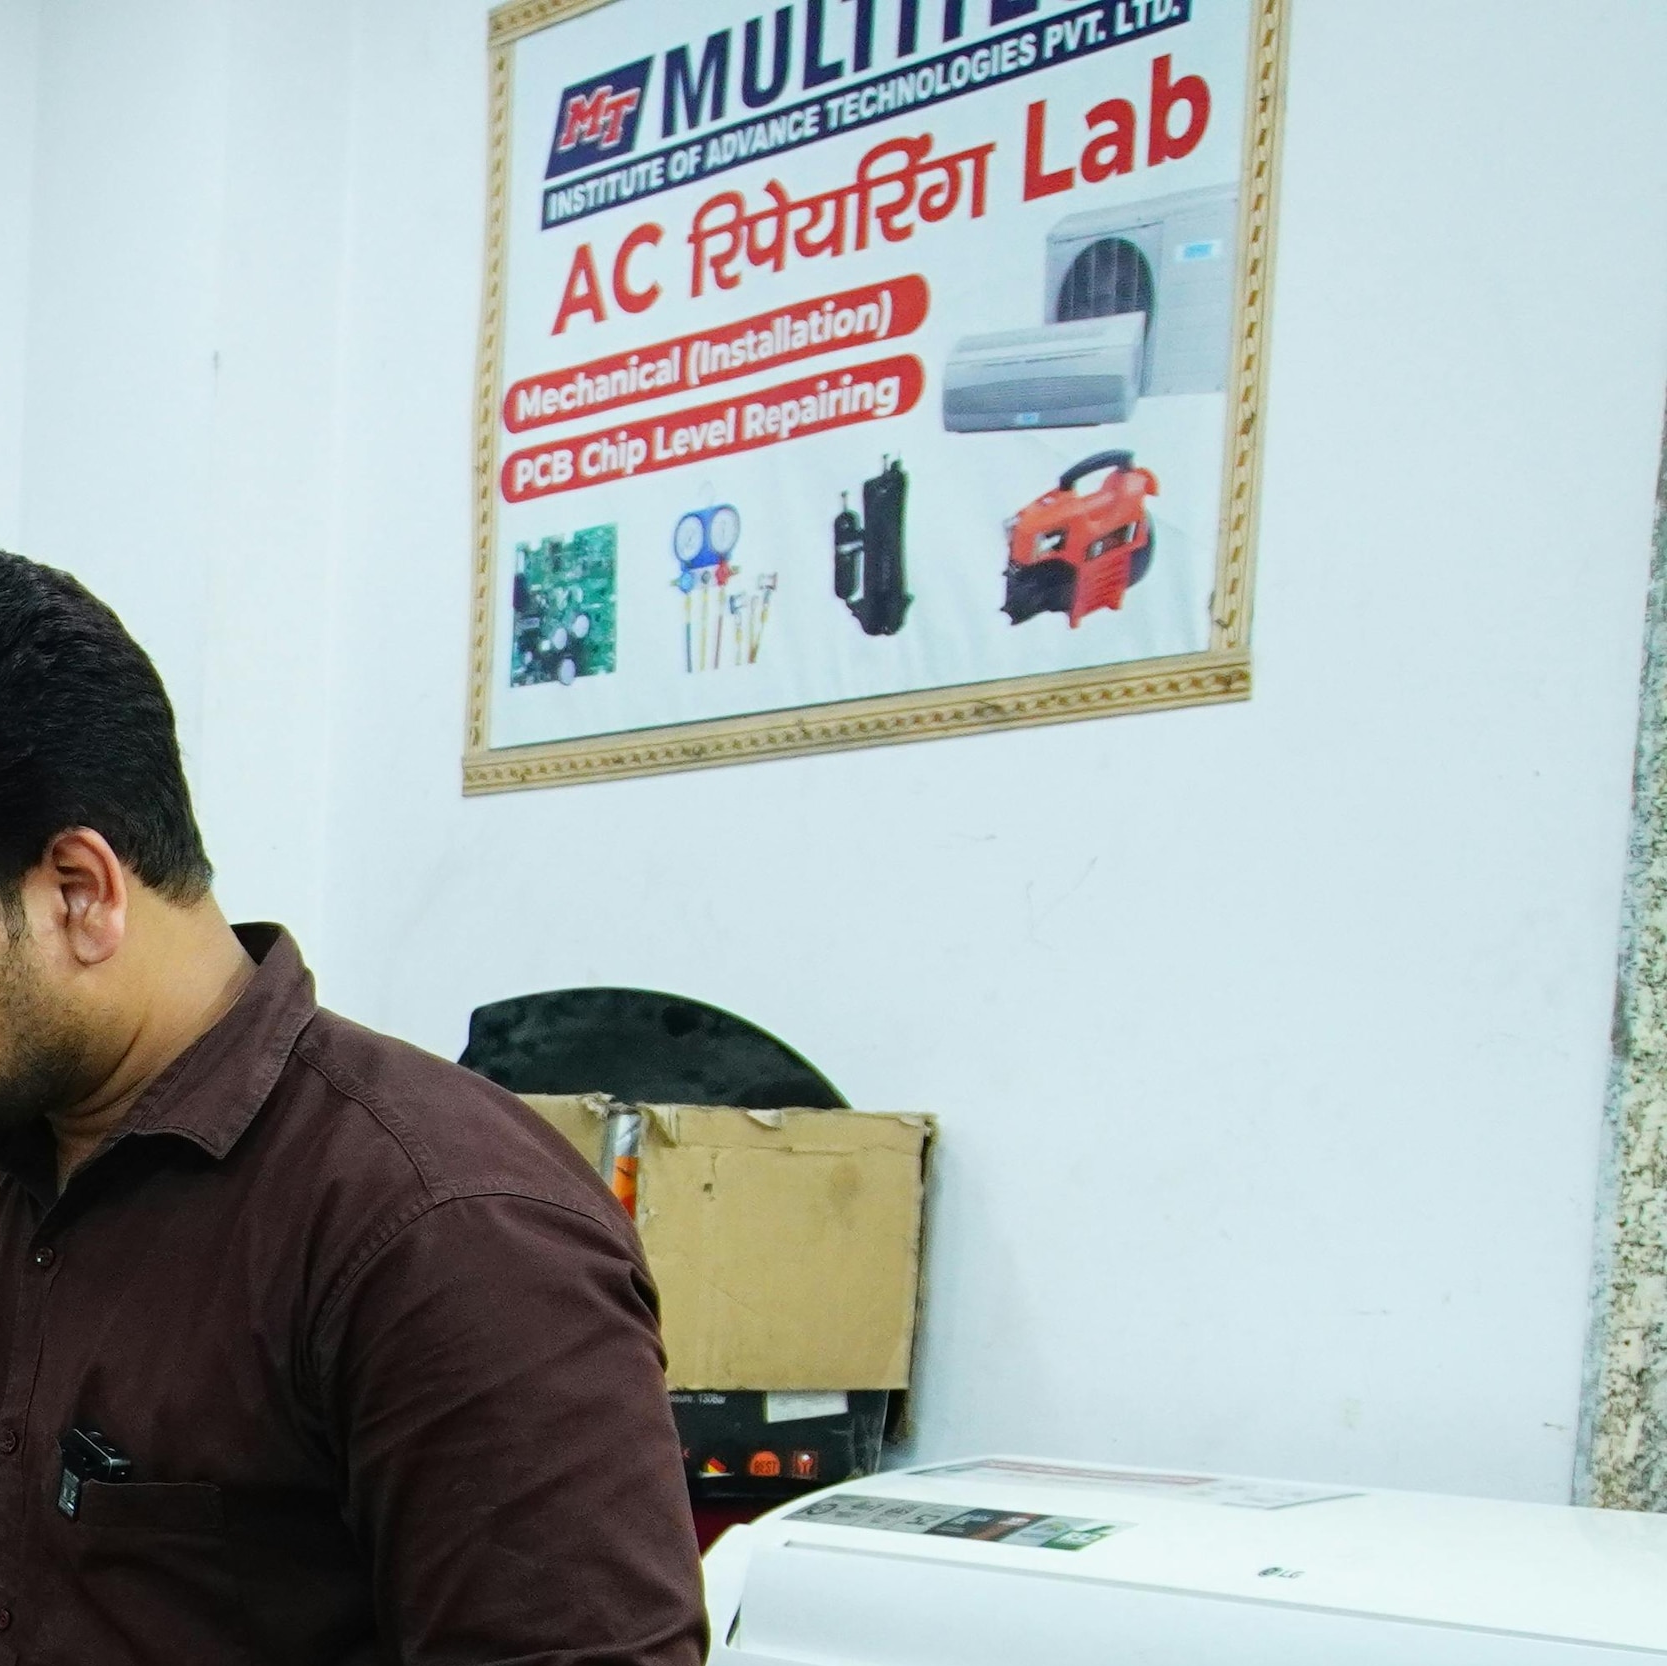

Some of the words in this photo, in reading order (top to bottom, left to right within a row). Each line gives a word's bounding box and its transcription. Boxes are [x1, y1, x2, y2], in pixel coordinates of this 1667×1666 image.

[547, 156, 665, 222] INSTITUTE
[667, 147, 702, 181] OF
[705, 105, 819, 169] ADVANCE
[825, 32, 1037, 129] TECHNOLOGIES
[1044, 9, 1106, 59] PVT.
[557, 85, 641, 150] MT
[551, 222, 665, 336] AC
[688, 132, 997, 298] रिपेयरिंग
[1023, 53, 1212, 202] Lab
[516, 346, 681, 422] Mechanical
[686, 290, 893, 386] (Installation)
[513, 449, 574, 494] PCB
[580, 430, 648, 476] Chip
[654, 408, 737, 462] Level
[741, 374, 900, 440] Repairing
